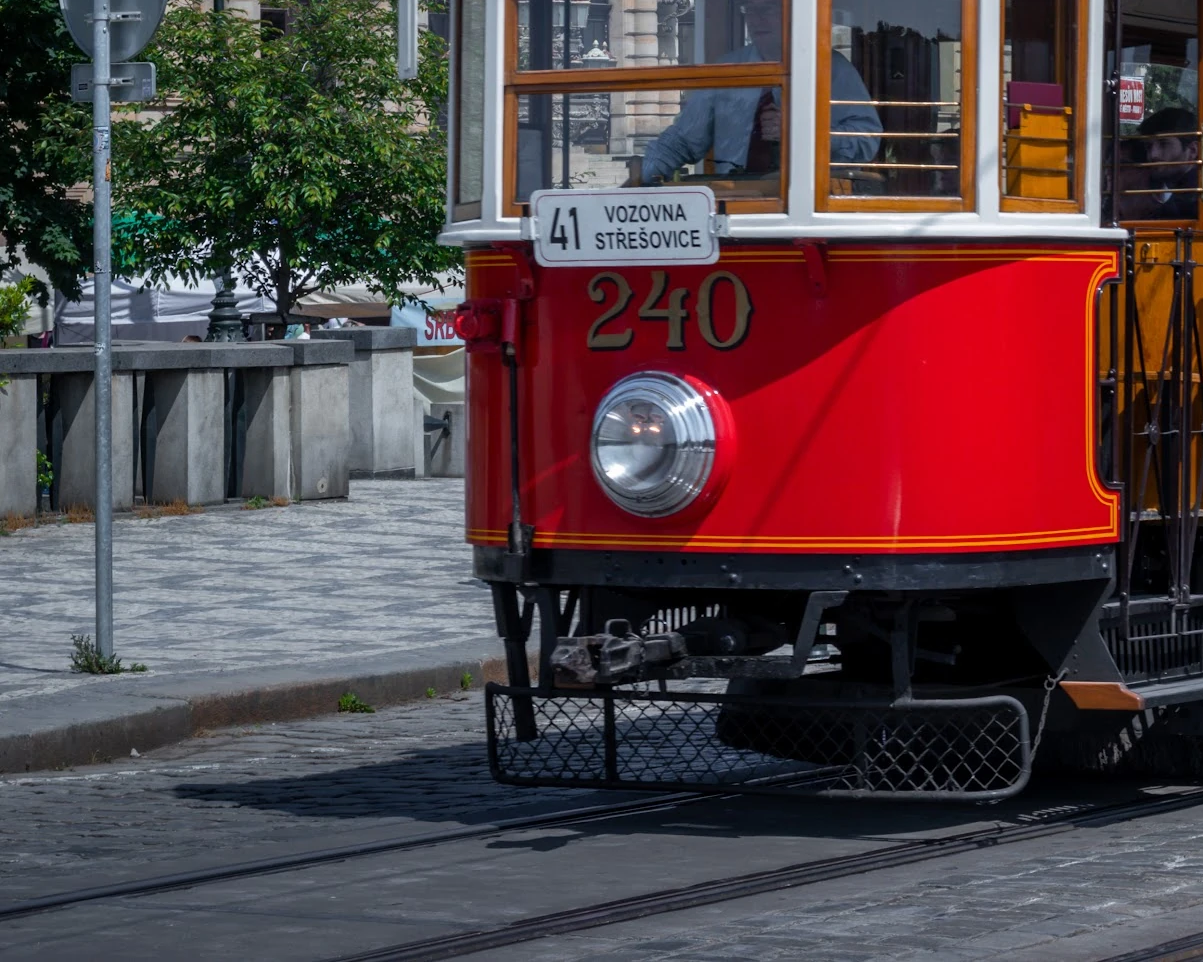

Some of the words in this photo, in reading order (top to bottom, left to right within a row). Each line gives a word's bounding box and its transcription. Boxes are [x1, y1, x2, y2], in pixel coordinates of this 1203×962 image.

[550, 207, 581, 250] 41
[604, 203, 687, 223] VOZOVNA
[595, 227, 702, 250] STŘEŠOVICE
[424, 309, 467, 340] SRB
[587, 270, 754, 351] 240
